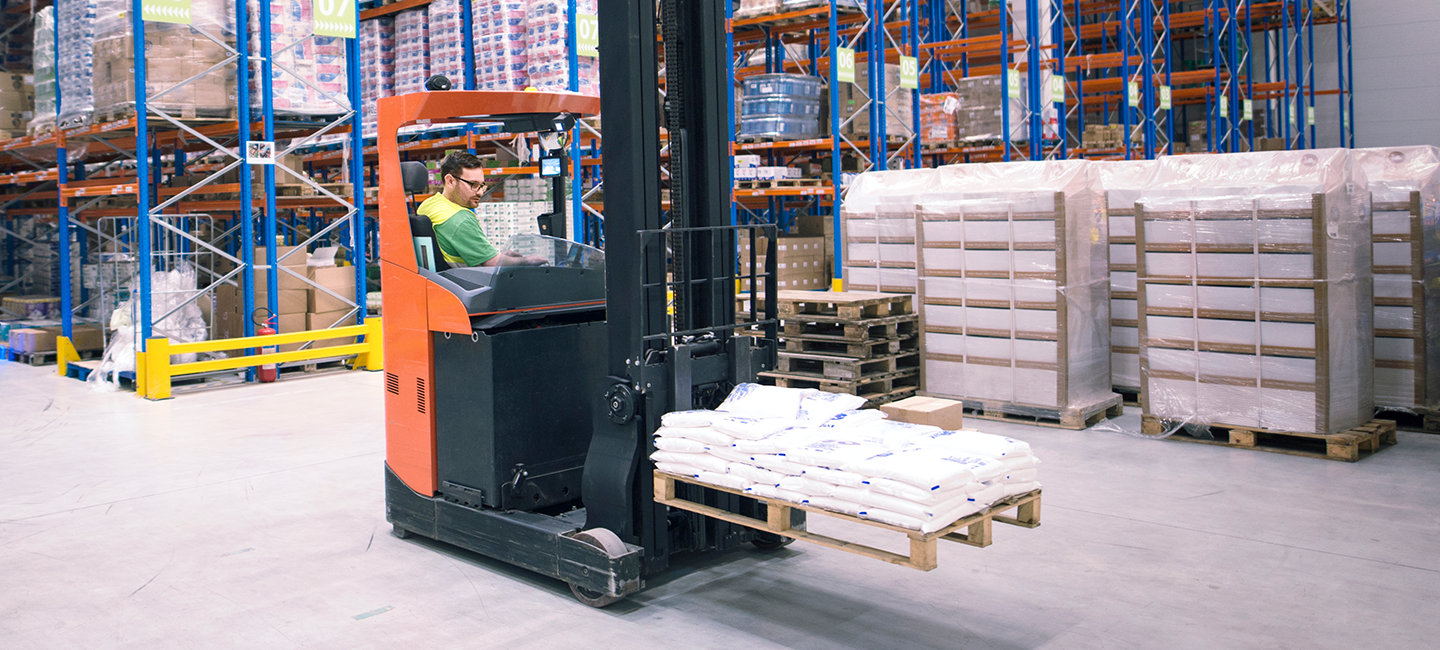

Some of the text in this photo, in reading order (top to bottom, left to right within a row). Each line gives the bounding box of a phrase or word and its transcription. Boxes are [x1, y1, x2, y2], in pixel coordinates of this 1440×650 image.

[579, 18, 598, 40] 07
[839, 51, 853, 69] 06
[902, 59, 916, 76] 05
[1009, 72, 1019, 87] 05
[1052, 78, 1063, 92] 04
[1161, 88, 1170, 101] 03
